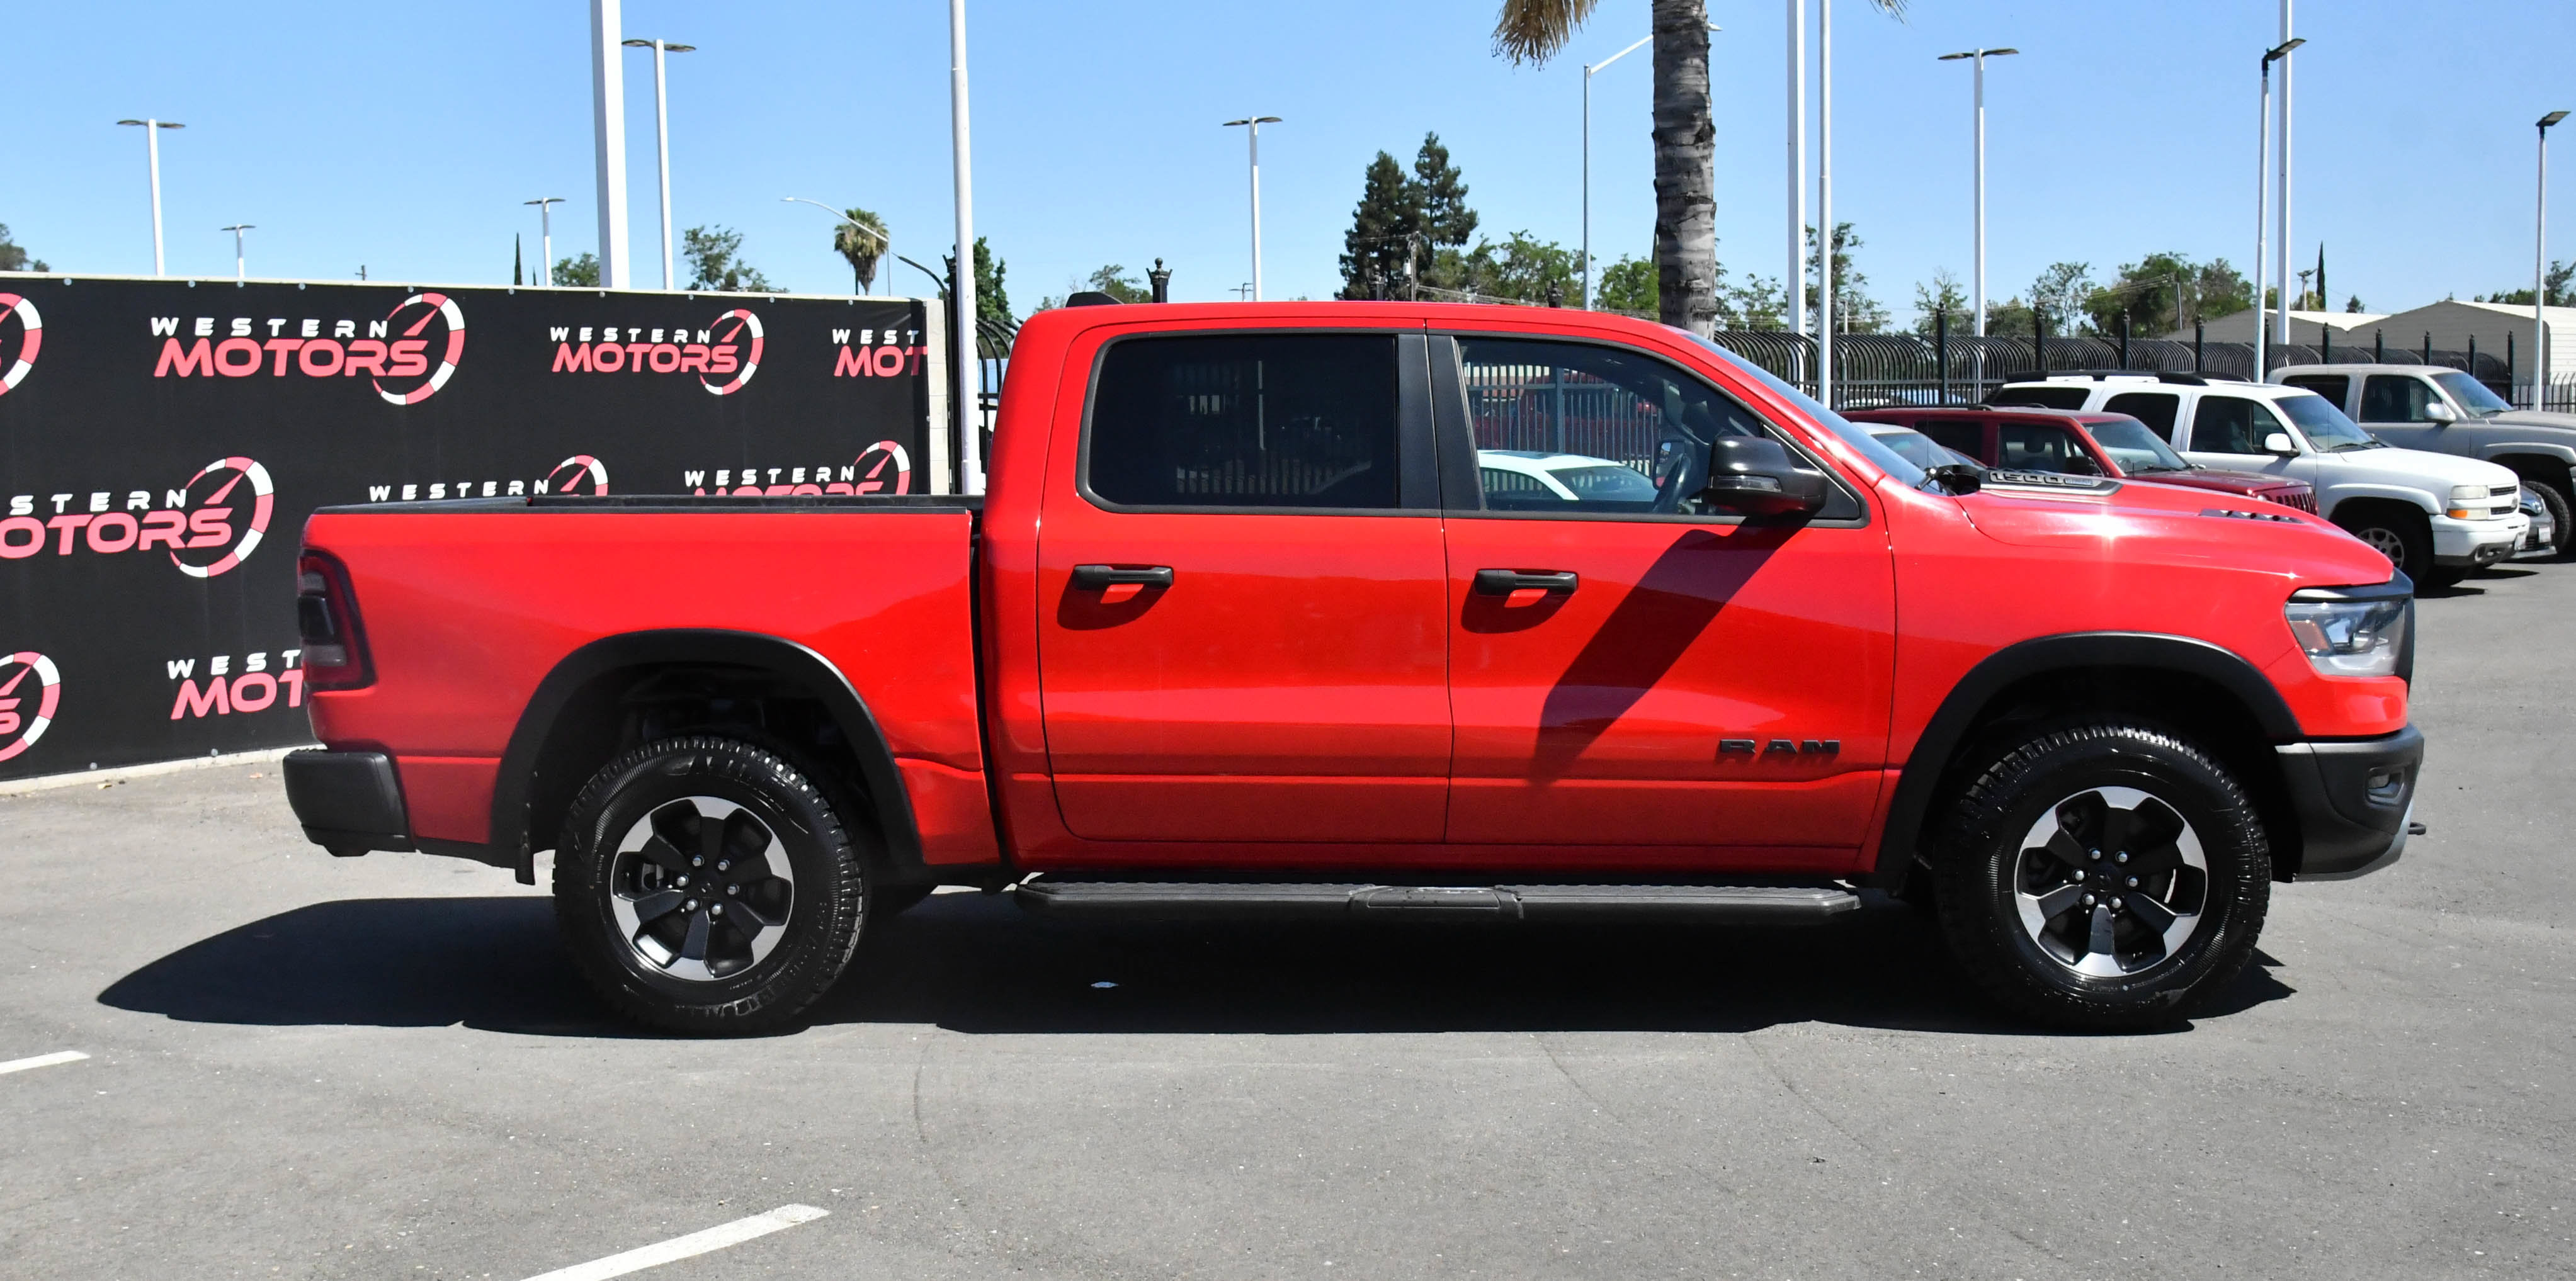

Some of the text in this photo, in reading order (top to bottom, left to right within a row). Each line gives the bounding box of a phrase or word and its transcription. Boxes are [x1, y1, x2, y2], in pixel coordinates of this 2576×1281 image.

[150, 317, 388, 338] WESTERN
[549, 327, 710, 344] WESTERN
[154, 338, 429, 377] MOTORS
[552, 342, 739, 373] MOTORS
[684, 466, 854, 487] WESTERN
[1991, 471, 2063, 485] 1500
[369, 479, 549, 502] WESTERN
[1720, 739, 1840, 754] RAM
